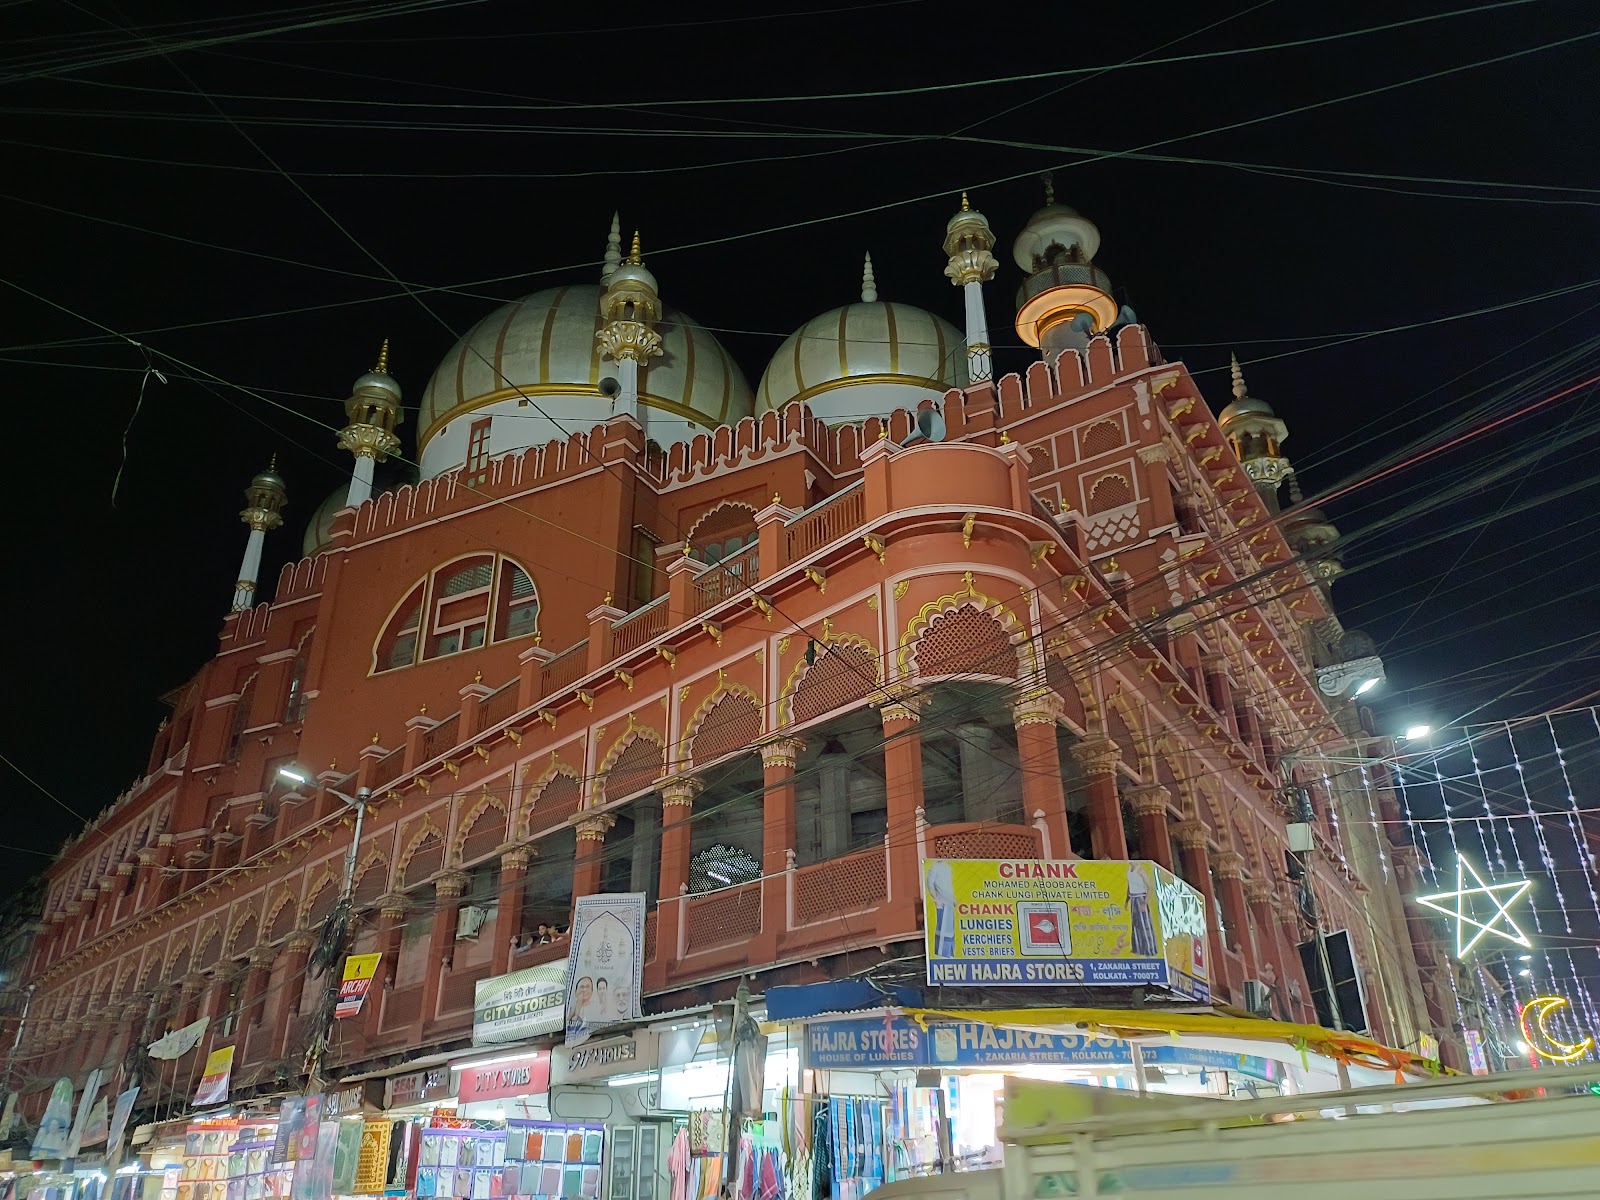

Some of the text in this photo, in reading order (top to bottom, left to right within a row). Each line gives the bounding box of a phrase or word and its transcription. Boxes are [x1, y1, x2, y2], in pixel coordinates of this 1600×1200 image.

[999, 863, 1078, 879] CHANK
[983, 880, 1097, 889] MOHAMED ABOOBACKER
[972, 890, 1110, 899] CHANK LUNGI PRIVATE LIMITED
[958, 903, 1015, 915] CHANK
[960, 919, 1013, 930] LUNGIES
[963, 934, 1012, 945] KERCHIEFS
[962, 947, 1015, 956] VESTS BRIEFS
[933, 963, 1085, 981] NEW HAJRA STORES
[1089, 962, 1160, 972] 1, ZAKARIA STREET
[1092, 972, 1128, 980] KOLKATA
[1133, 972, 1160, 980] 700073
[483, 991, 564, 1022] CITY STORES
[812, 1028, 919, 1052] HAJRA STORES
[960, 1024, 1054, 1050] HAJRA
[819, 1051, 914, 1062] HOUSE OF LUNGIES
[974, 1053, 984, 1062] 1,
[985, 1052, 1027, 1061] ZAKARIA
[1071, 1051, 1115, 1060] KOLKATA
[475, 1066, 532, 1093] CITY STORES
